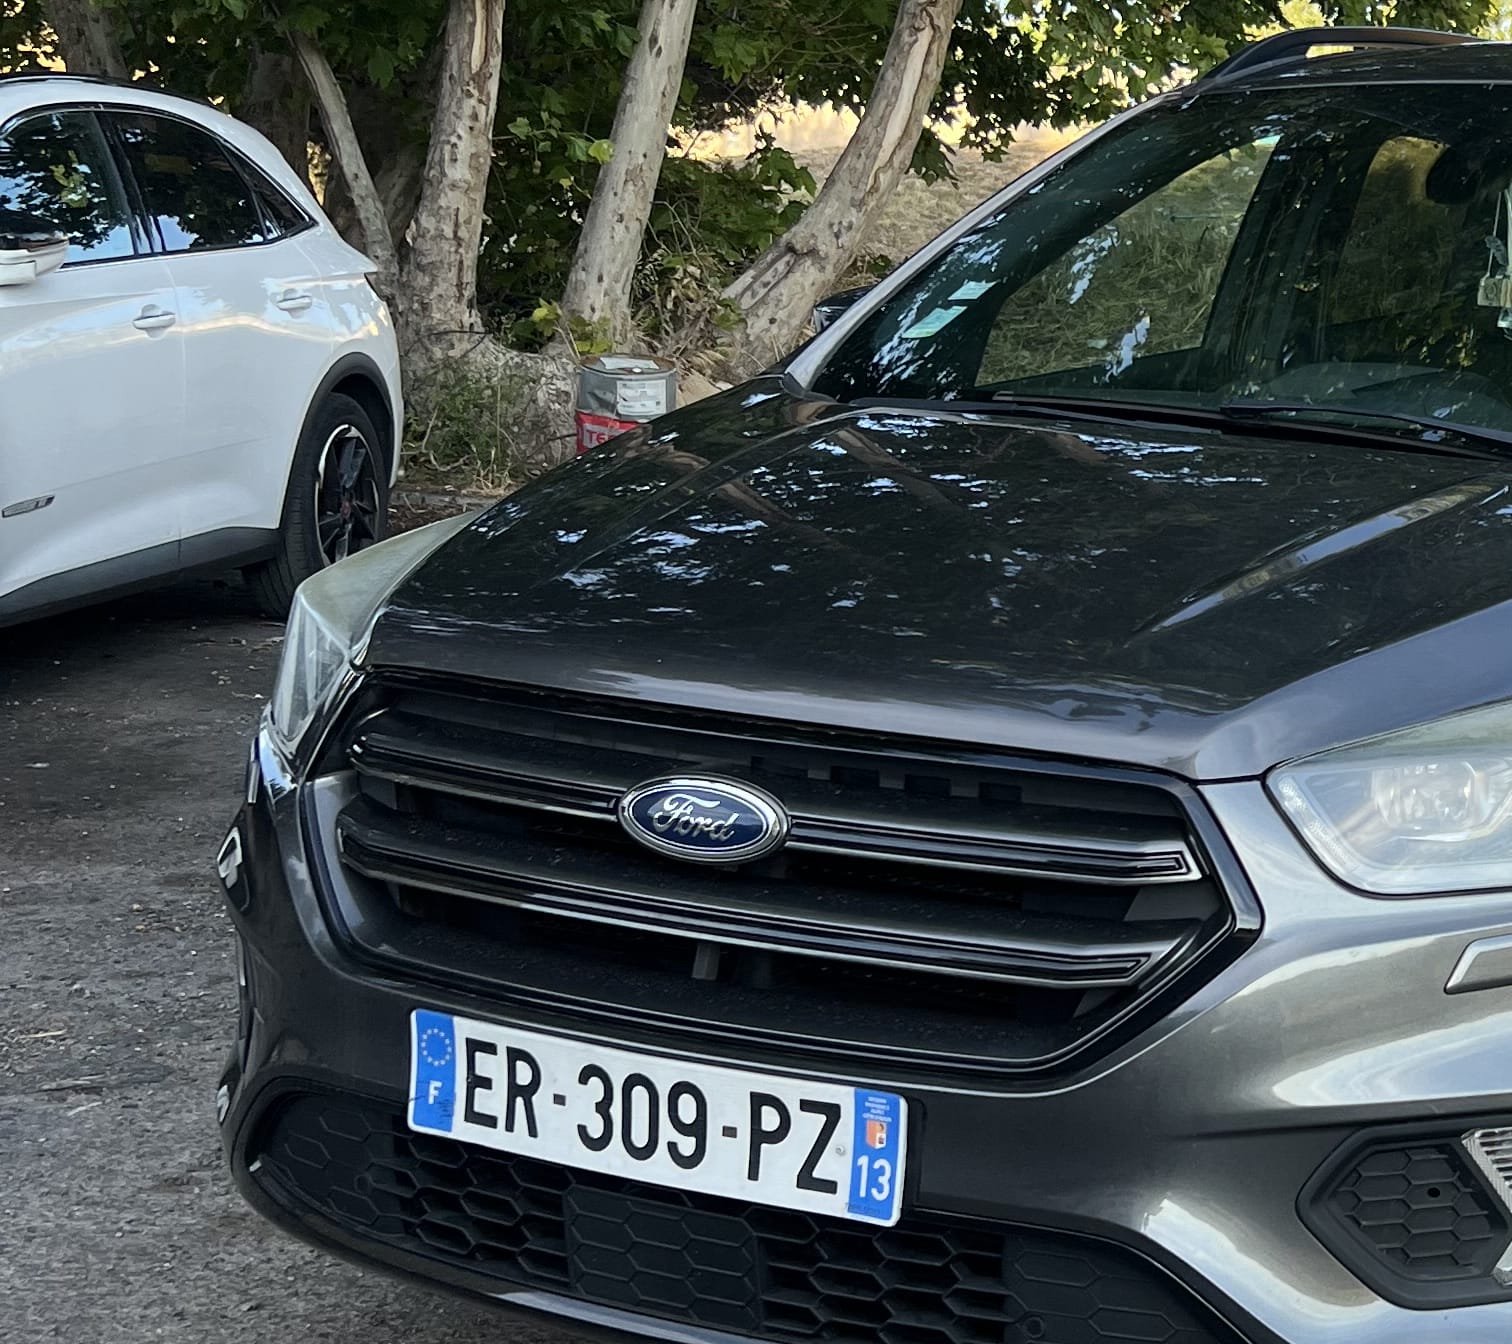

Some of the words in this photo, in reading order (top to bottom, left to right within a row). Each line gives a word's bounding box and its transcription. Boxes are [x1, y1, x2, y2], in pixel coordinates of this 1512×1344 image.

[652, 793, 740, 842] Ford
[427, 1080, 442, 1105] F
[463, 1037, 842, 1195] ER-309-PZ
[856, 1154, 892, 1201] 13
